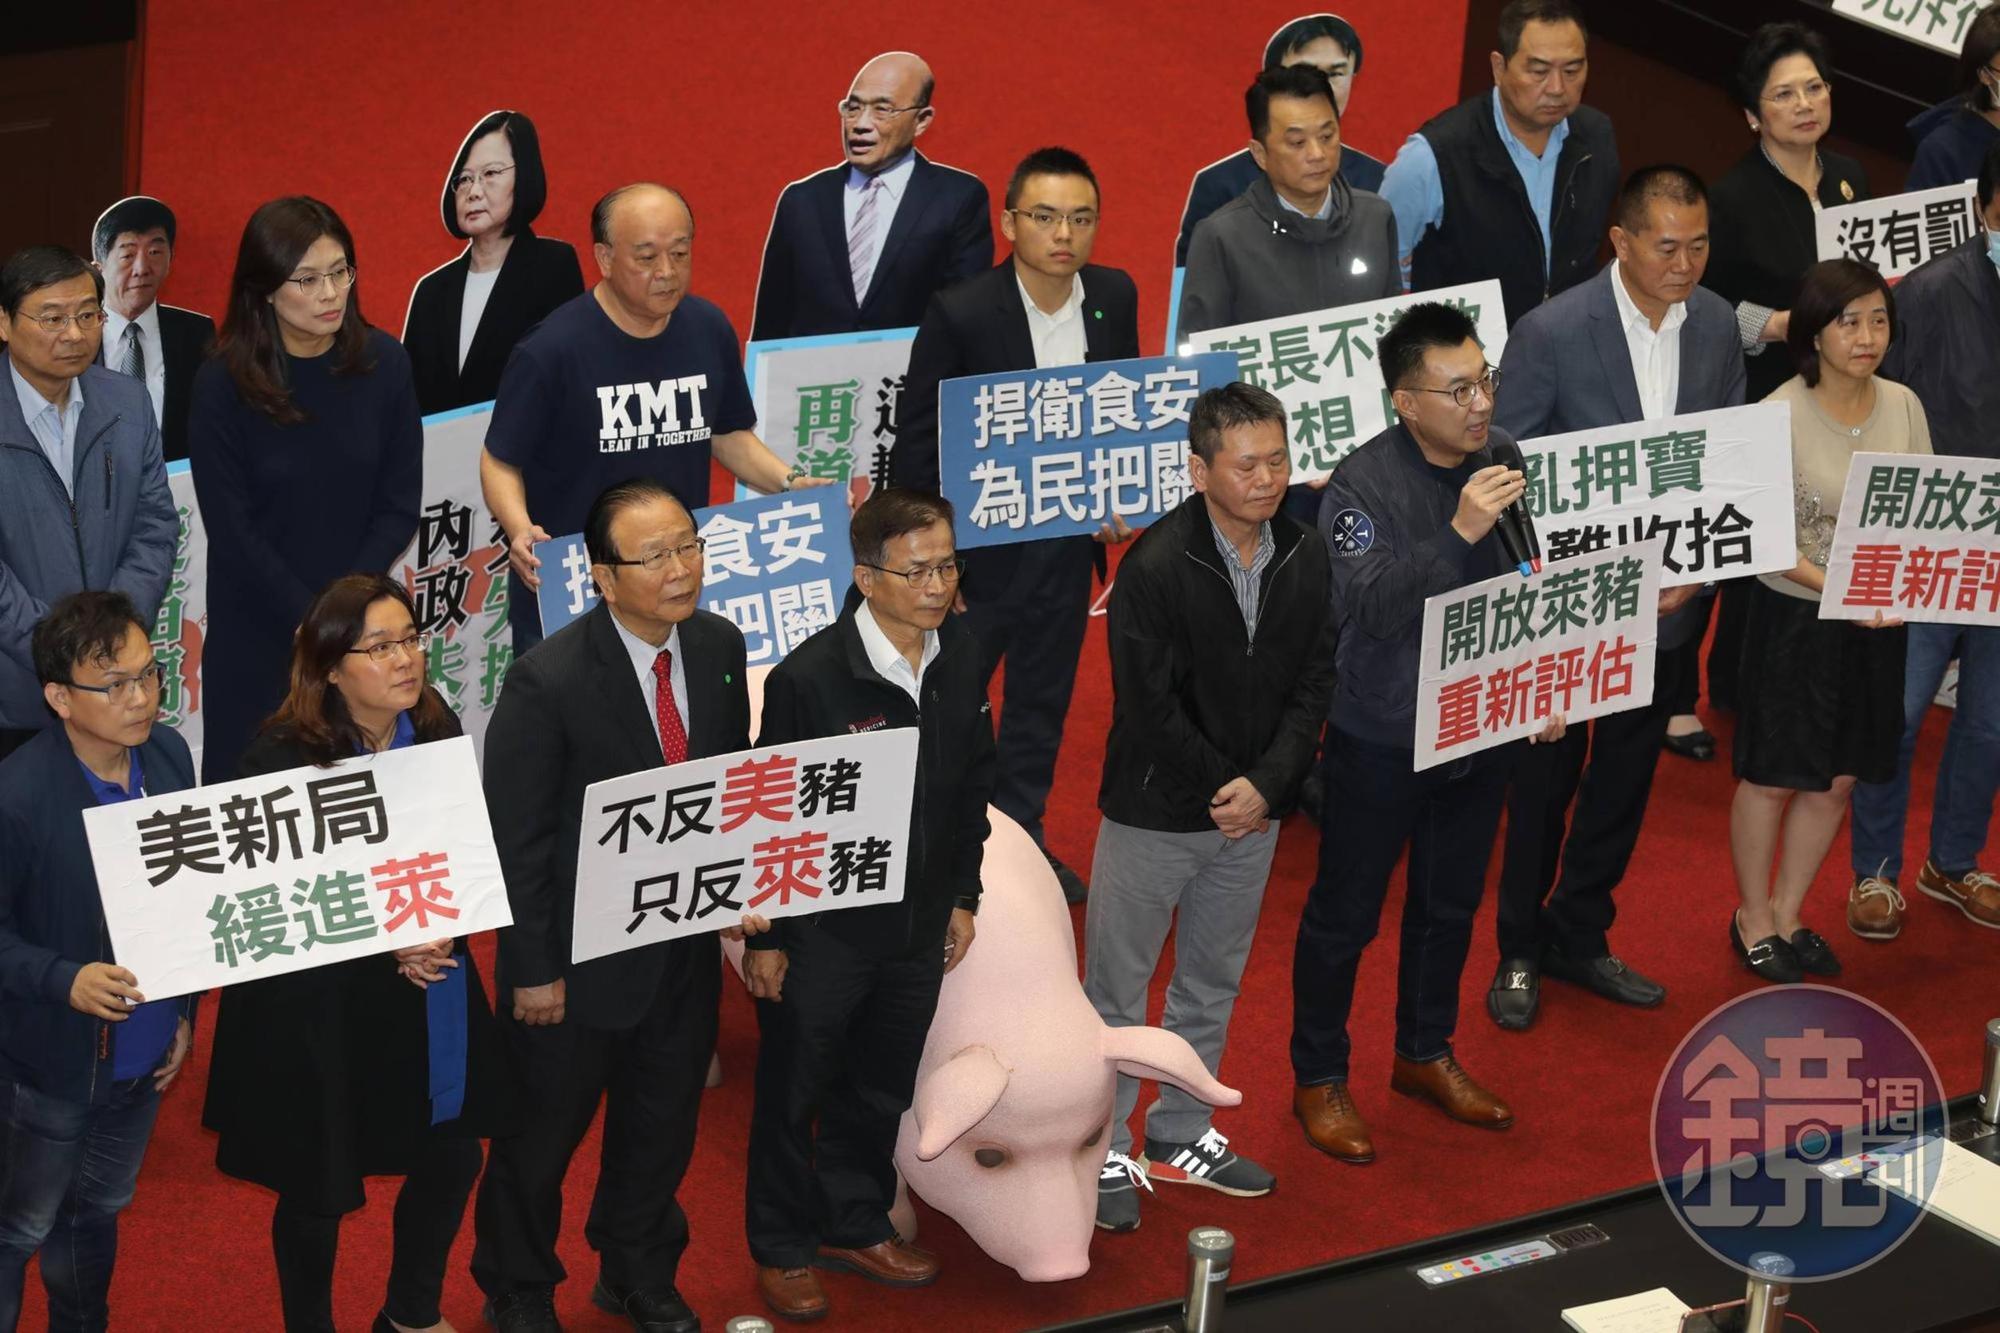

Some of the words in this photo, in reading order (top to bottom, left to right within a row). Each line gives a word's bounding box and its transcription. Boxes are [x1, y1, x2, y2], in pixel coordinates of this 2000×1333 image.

[1836, 197, 1976, 270] 沒有罰
[1210, 296, 1485, 391] 院長不
[596, 374, 707, 439] KMT
[599, 438, 632, 453] LEAN
[637, 435, 650, 450] IN
[655, 427, 712, 447] TOGETHER
[973, 365, 1200, 449] 捍衛食安
[968, 440, 1195, 530] 為民把關
[1440, 555, 1643, 671] 開放萊豬
[1842, 544, 2000, 613] 重新評
[1434, 634, 1638, 751] 重新評估
[136, 769, 390, 888] 美新局
[597, 754, 862, 854] 不反美豬
[205, 851, 461, 968] 緩進萊
[625, 830, 892, 935] 只反萊豬
